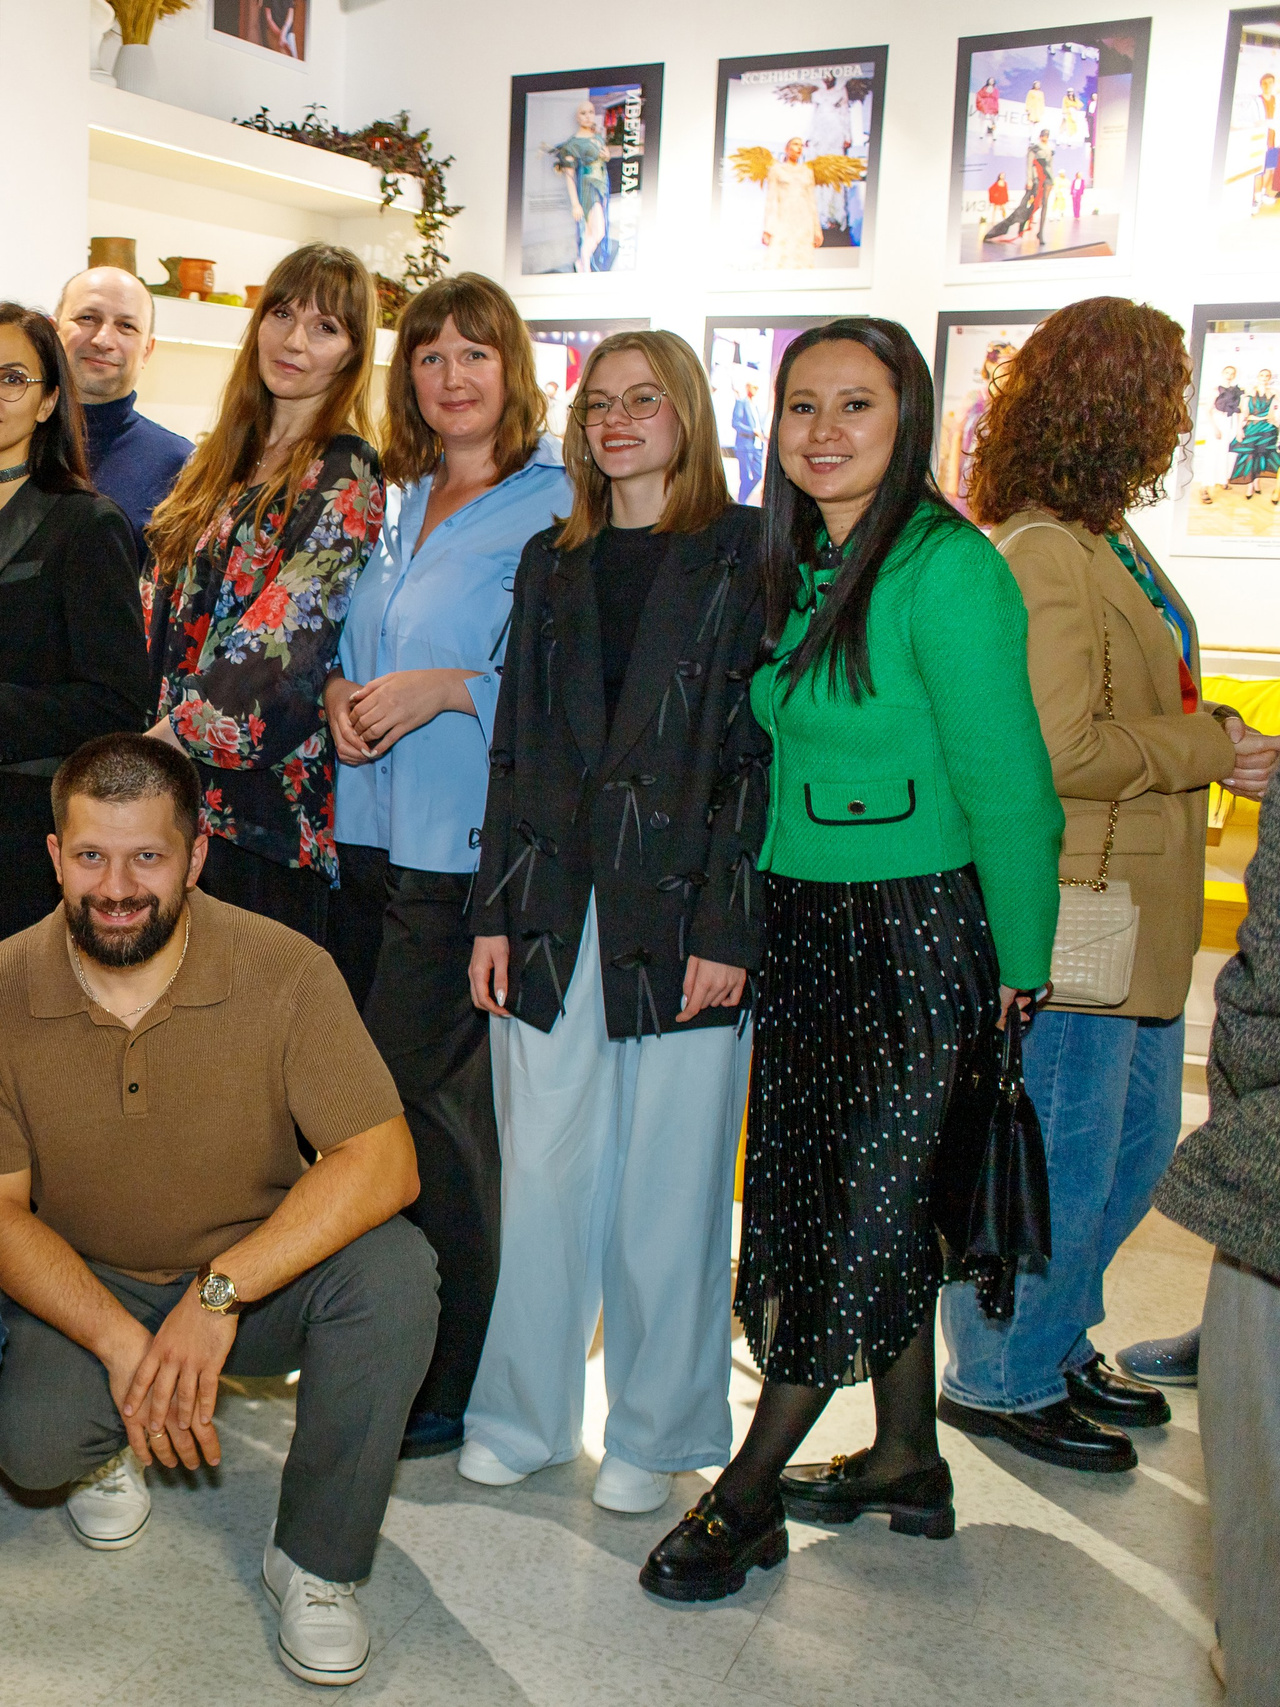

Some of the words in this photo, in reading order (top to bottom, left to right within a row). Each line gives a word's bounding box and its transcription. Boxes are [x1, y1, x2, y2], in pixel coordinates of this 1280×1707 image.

[740, 71, 799, 86] КСЕНИЯ
[800, 65, 863, 81] РЫКОВА
[622, 88, 643, 159] ИВЕТА
